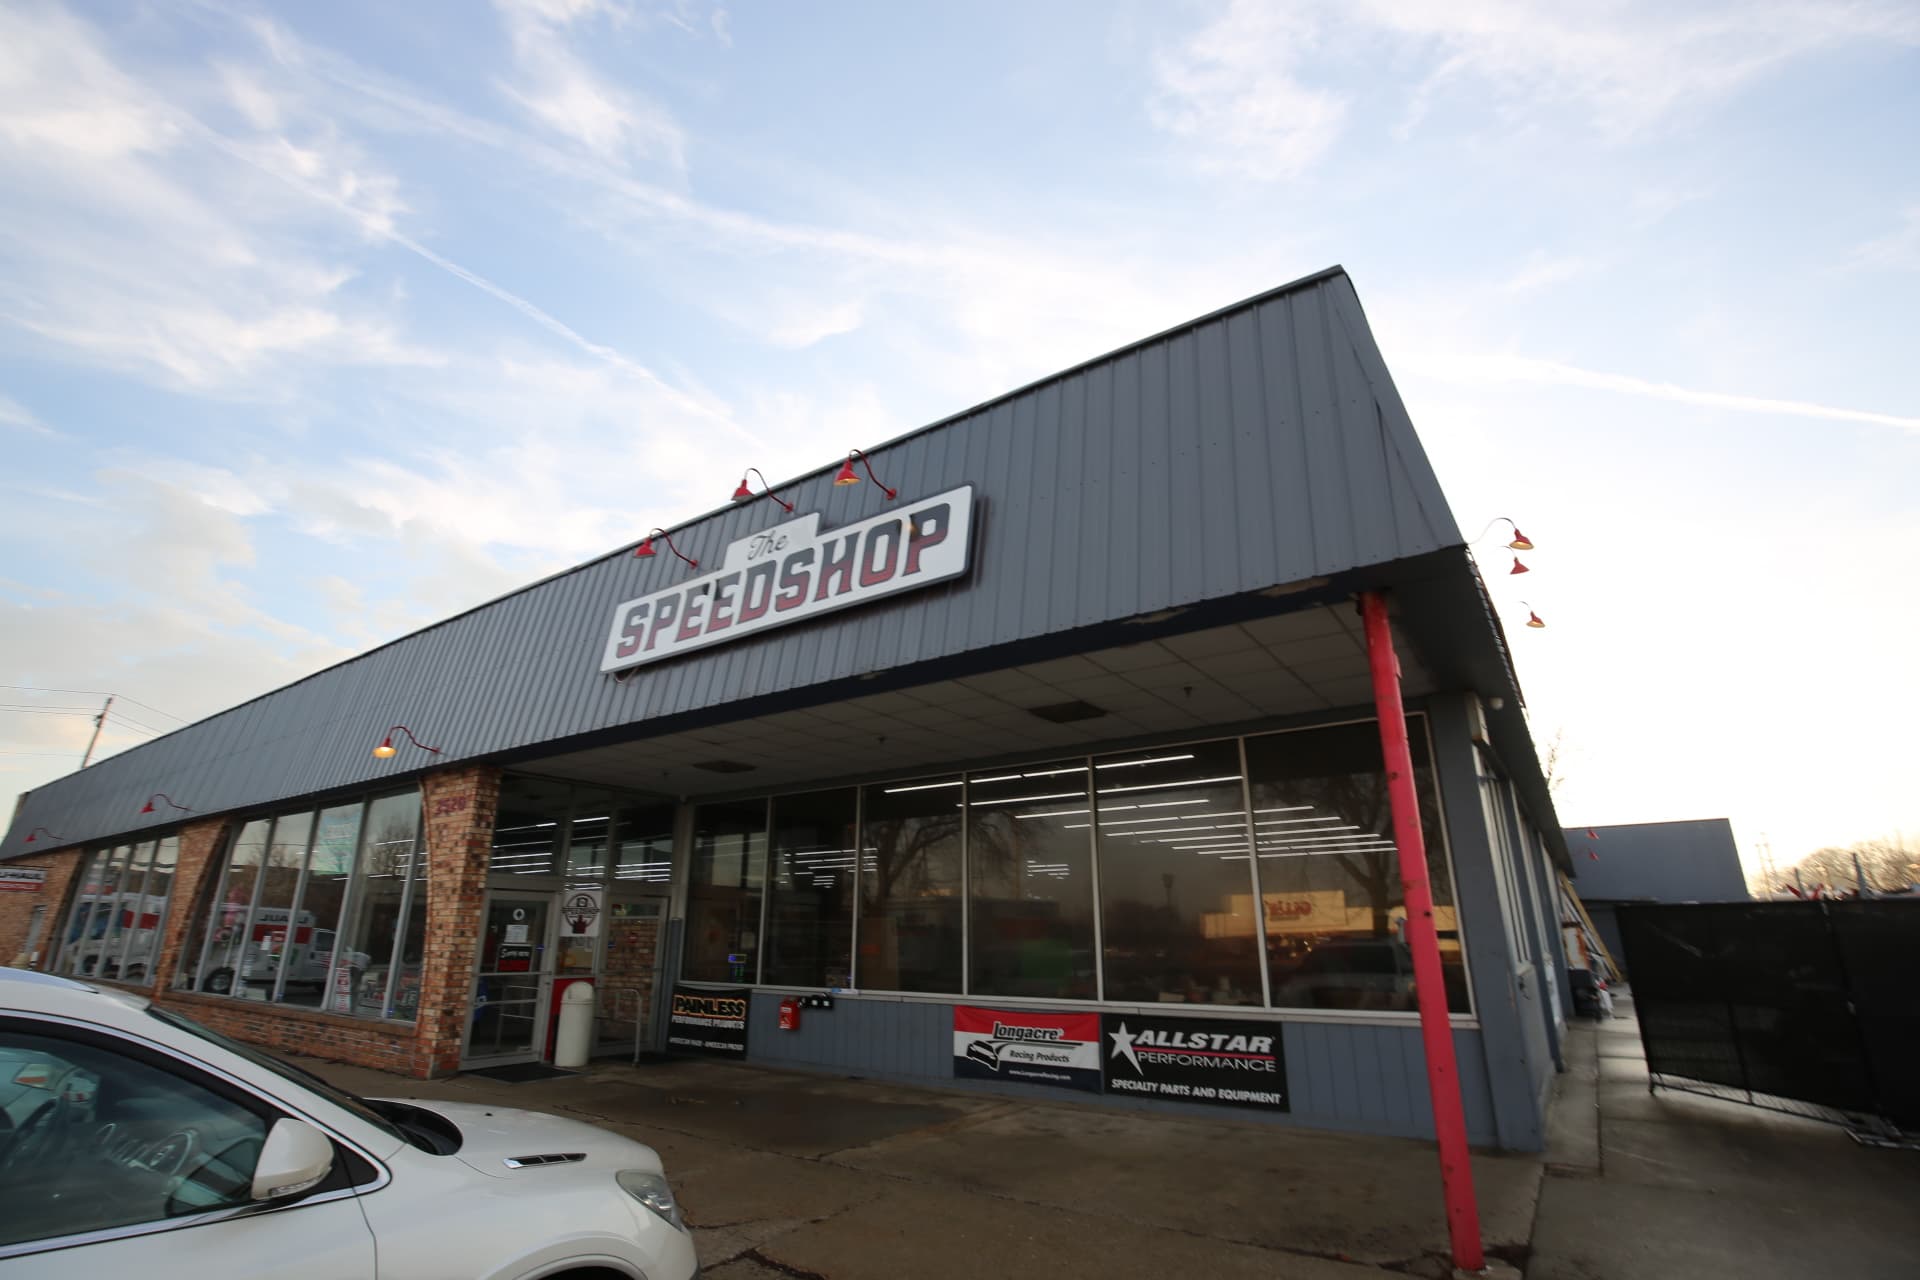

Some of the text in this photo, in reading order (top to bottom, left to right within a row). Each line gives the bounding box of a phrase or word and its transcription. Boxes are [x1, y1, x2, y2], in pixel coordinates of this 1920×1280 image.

[747, 529, 787, 560] The
[616, 503, 951, 659] SPEEDSHOP
[672, 994, 746, 1019] PAINLESS
[993, 1021, 1059, 1041] Longacre
[1135, 1030, 1273, 1053] ALLSTAR
[1010, 1050, 1070, 1063] Racing Products
[1138, 1051, 1276, 1072] PERFORMANCE
[1112, 1078, 1281, 1104] SPECIALTY PARTS AND EQUIPMENT
